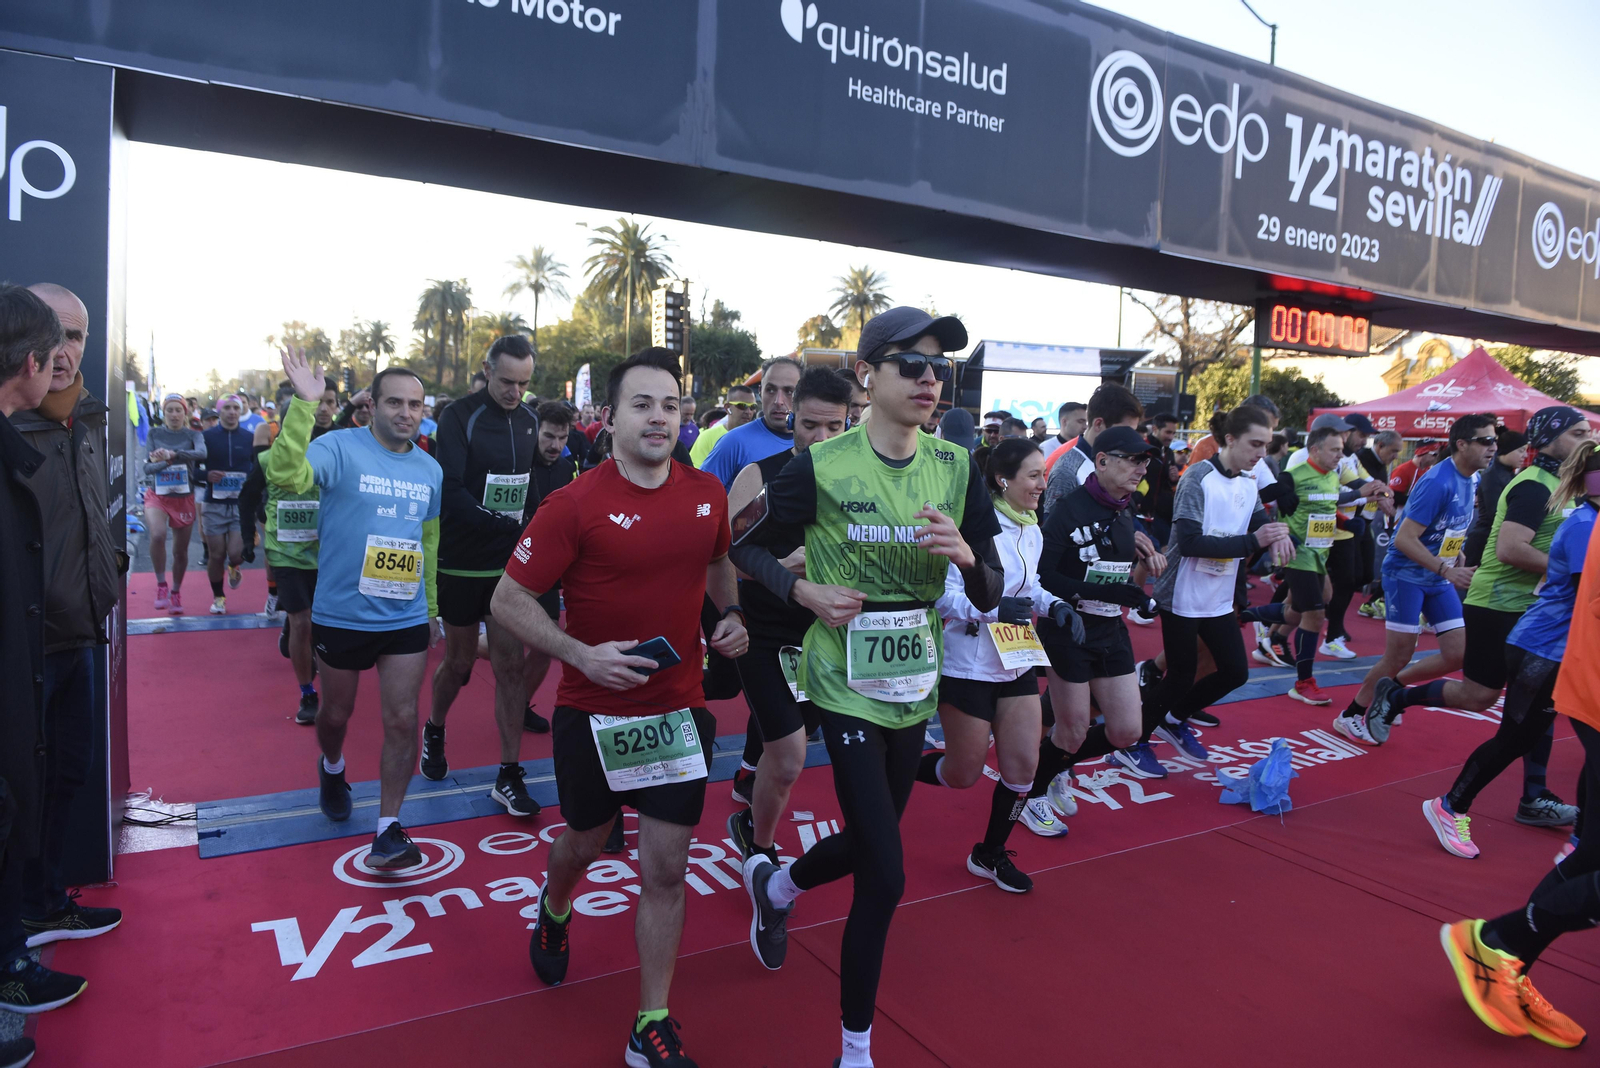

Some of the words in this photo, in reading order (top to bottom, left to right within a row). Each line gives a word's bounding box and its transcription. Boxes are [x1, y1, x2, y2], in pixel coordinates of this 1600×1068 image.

[817, 22, 1007, 95] quirónsalud
[848, 77, 941, 118] Healthcare
[946, 101, 1005, 133] Partner
[1169, 82, 1270, 180] edp
[1330, 127, 1473, 204] maratón
[1366, 184, 1473, 246] sevilla
[1256, 214, 1281, 242] 29
[1284, 225, 1337, 254] enero
[1340, 232, 1380, 263] 2023
[992, 398, 1065, 430] HOK
[934, 448, 955, 461] 2023
[360, 474, 392, 488] MEDIA
[394, 488, 407, 499] DE
[493, 487, 523, 503] 5161
[284, 511, 314, 524] 5987
[840, 501, 878, 513] HOKA
[847, 523, 890, 543] MEDIO
[375, 551, 415, 573] 8540
[872, 616, 890, 628] edp
[864, 633, 922, 664] 7066
[613, 721, 675, 757] 5290
